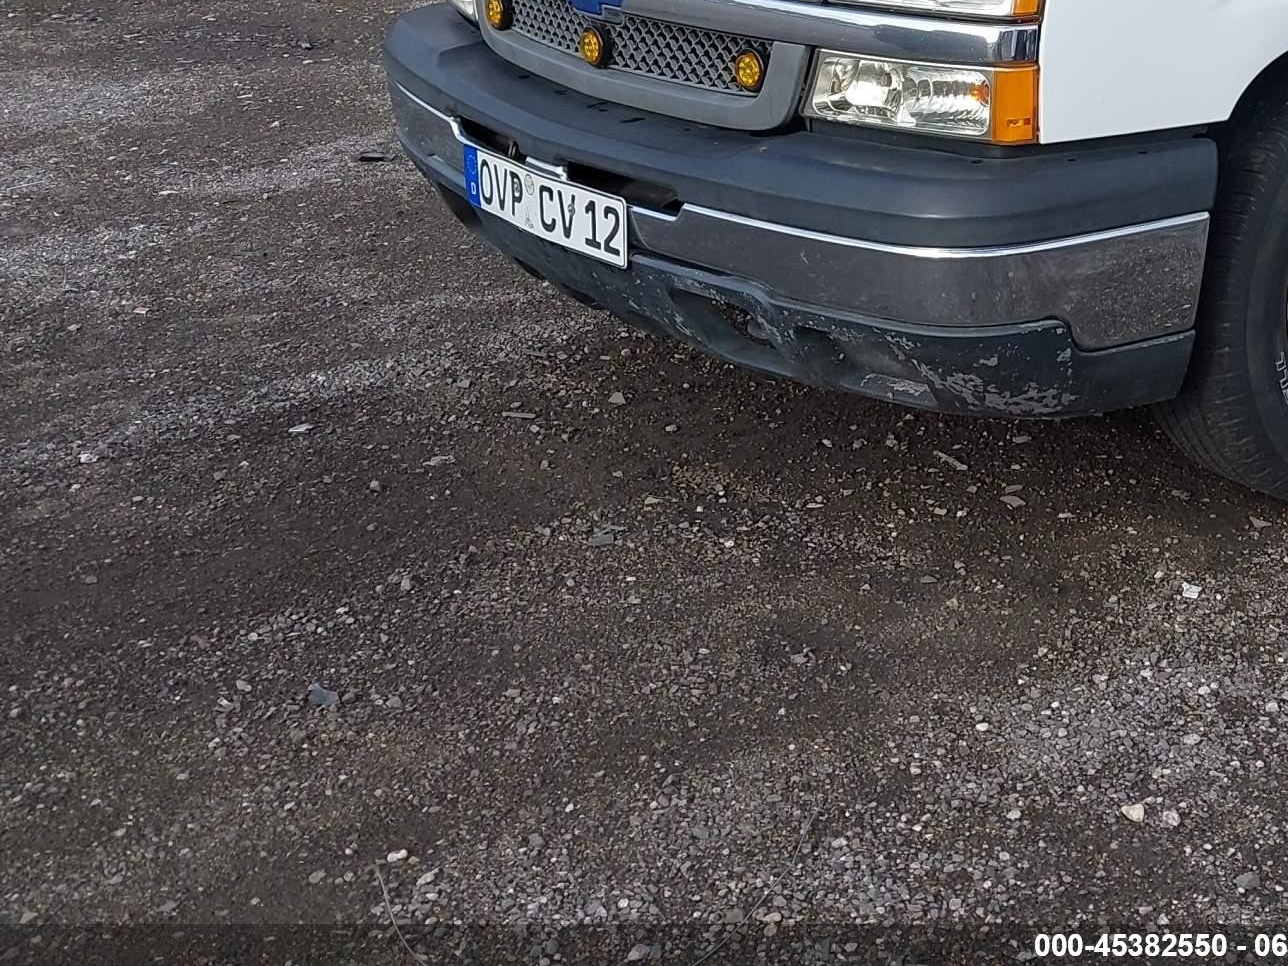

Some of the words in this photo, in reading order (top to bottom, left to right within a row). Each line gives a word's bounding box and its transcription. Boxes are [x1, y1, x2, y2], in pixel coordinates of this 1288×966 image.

[479, 158, 523, 216] OVP
[538, 184, 576, 239] CV
[584, 199, 621, 256] 12
